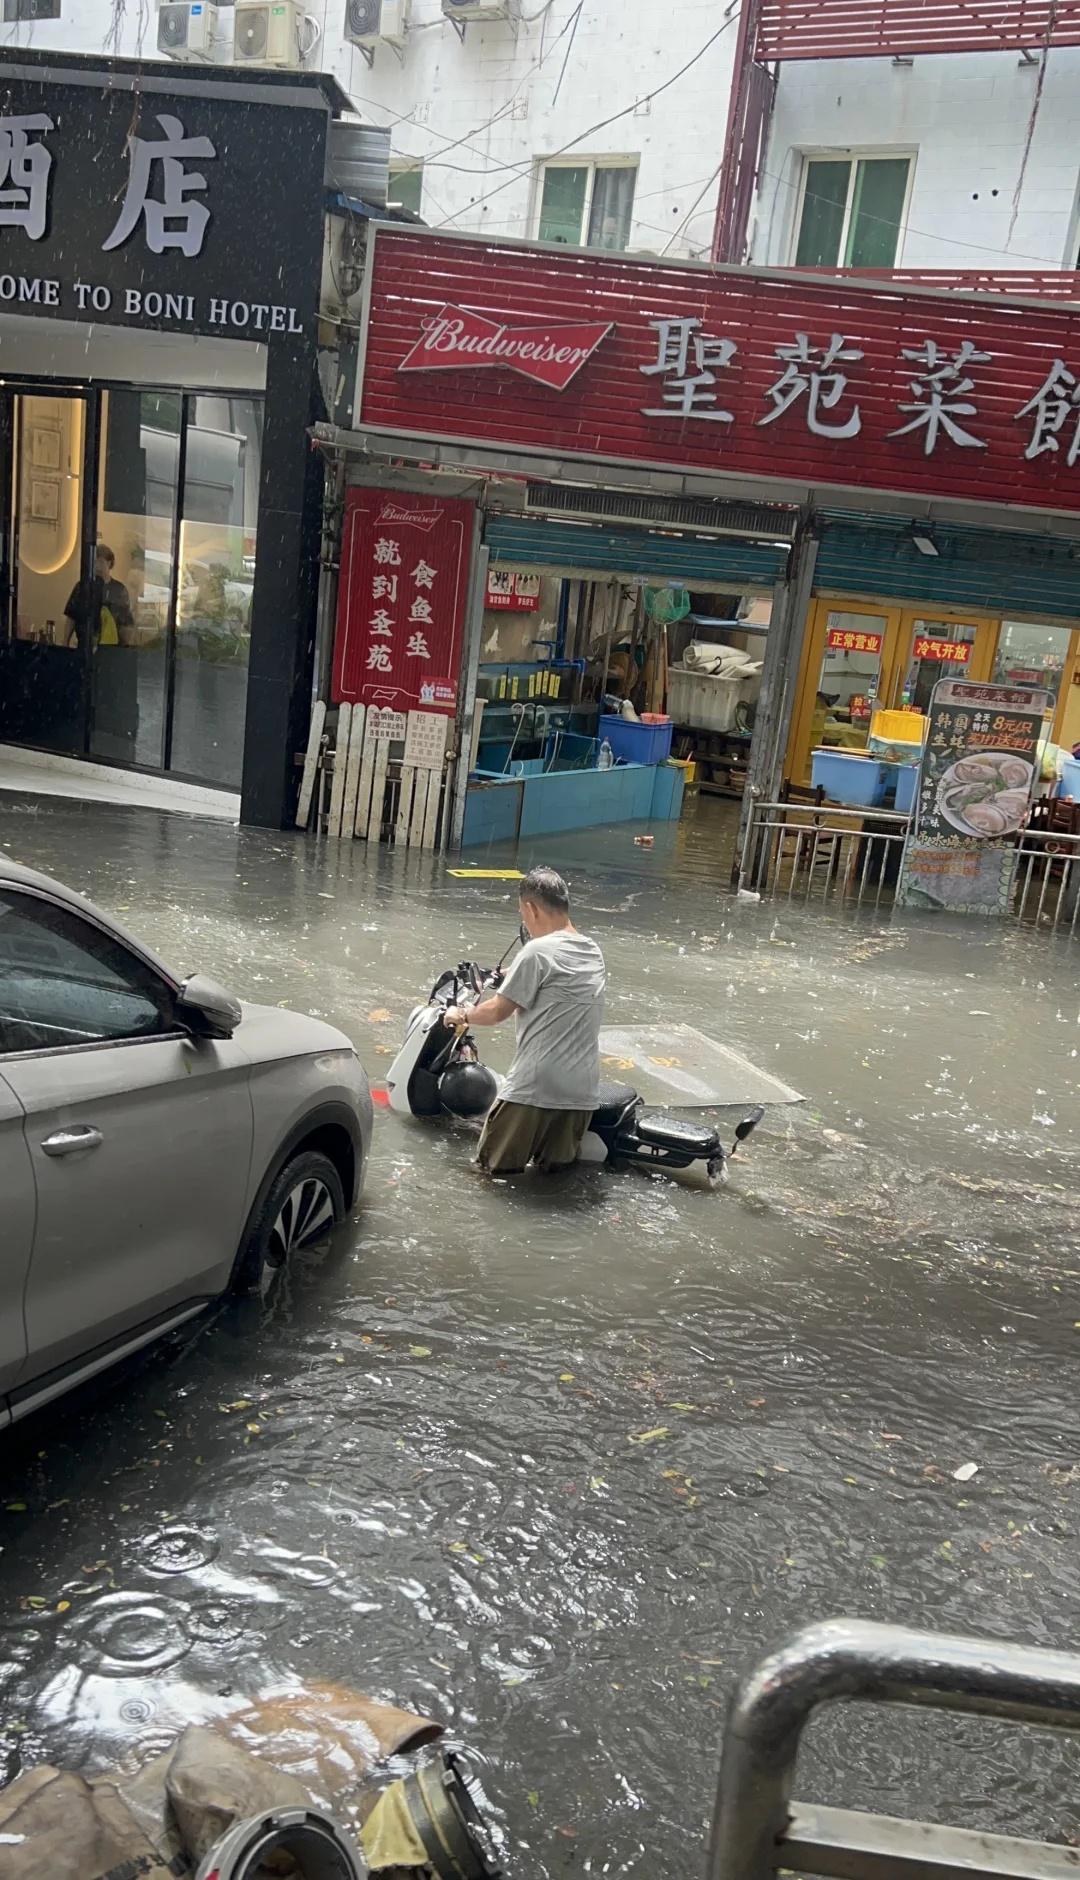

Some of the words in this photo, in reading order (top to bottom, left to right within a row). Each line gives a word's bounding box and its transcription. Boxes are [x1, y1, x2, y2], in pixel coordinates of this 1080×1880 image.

[73, 284, 111, 311] TO
[124, 289, 195, 321] BONI
[209, 298, 303, 333] HOTEL
[421, 316, 598, 365] Budweiser
[381, 506, 437, 524] Budweiser
[365, 537, 401, 672] 就到圣苑
[406, 559, 438, 660] 食鱼生
[831, 632, 878, 651] 正常营业
[917, 641, 967, 660] 冷气开放
[935, 712, 969, 730] 韩国
[972, 722, 990, 732] 特价
[974, 713, 991, 723] 全天
[992, 716, 1033, 734] 8元/只
[931, 732, 966, 748] 生蚝
